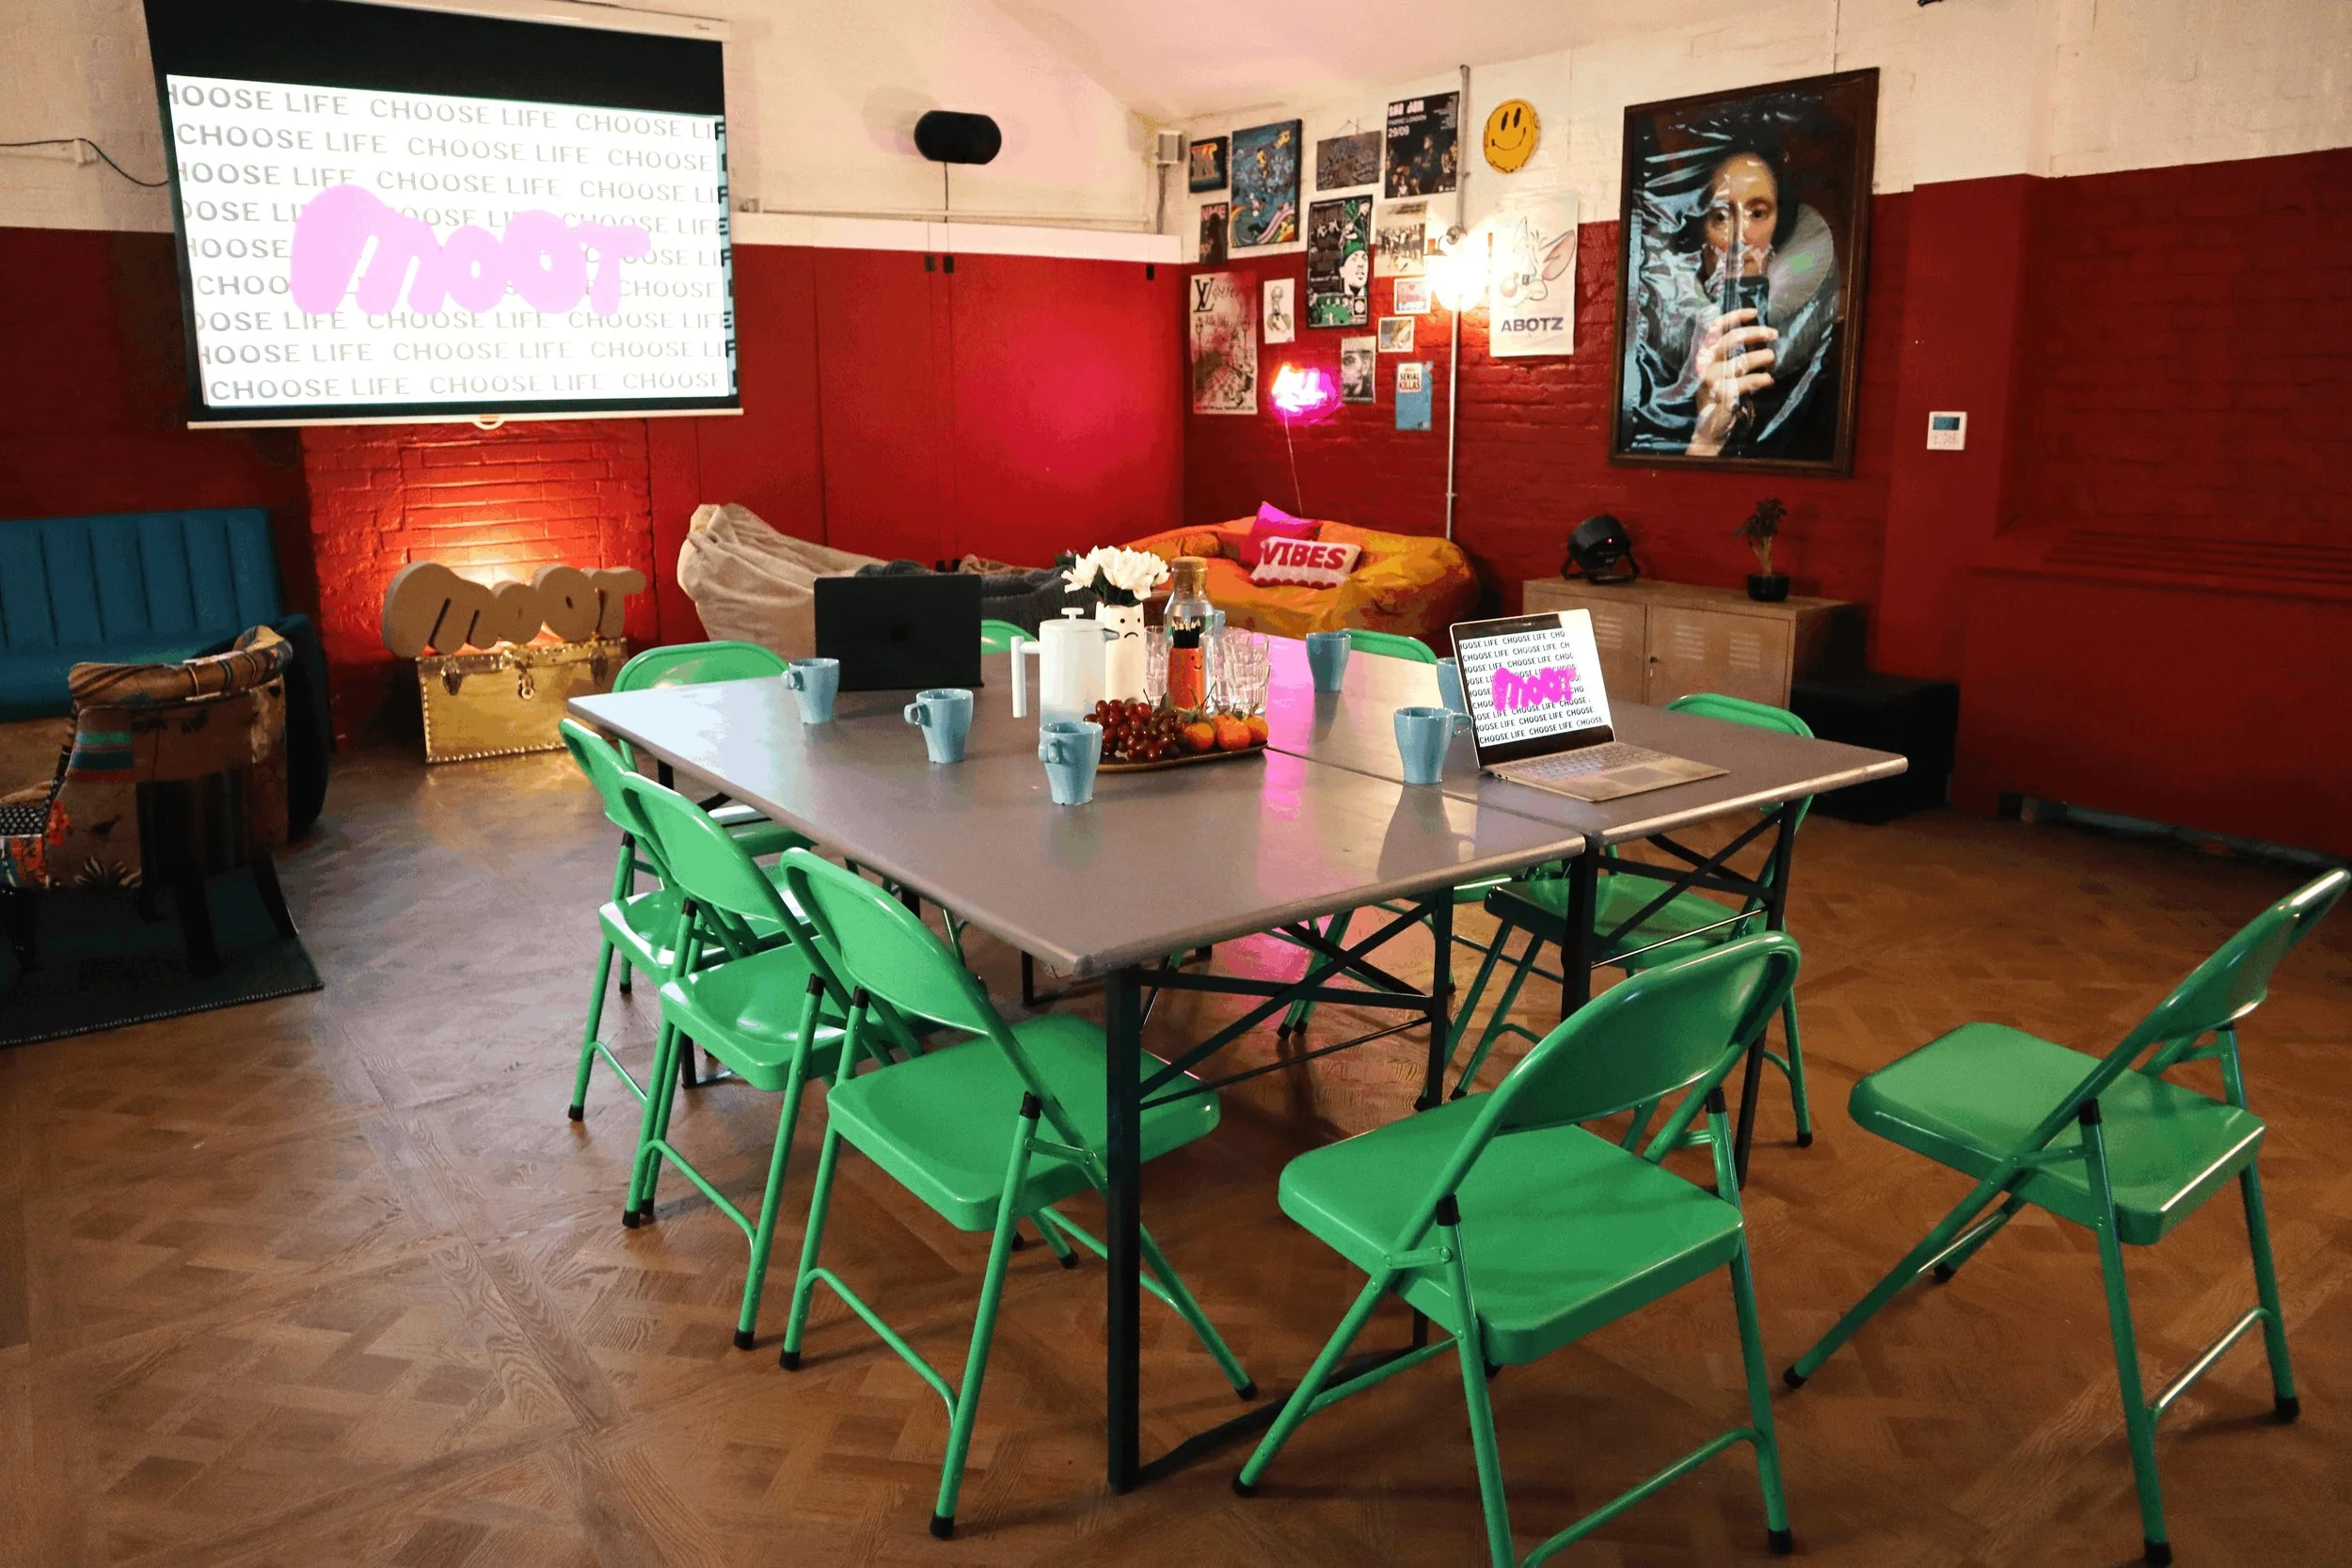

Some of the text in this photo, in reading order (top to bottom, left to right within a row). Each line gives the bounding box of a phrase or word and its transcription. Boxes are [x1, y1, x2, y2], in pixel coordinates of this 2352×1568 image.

[285, 92, 350, 115] LIFE
[370, 99, 490, 124] CHOOSE
[501, 107, 557, 128] LIFE
[575, 113, 682, 137] CHOOSE
[176, 123, 313, 150] CHOOSE
[325, 132, 388, 153] LIFE
[407, 136, 526, 161] CHOOSE
[535, 144, 590, 165] LIFE
[608, 149, 712, 171] CHOOSE
[293, 166, 355, 188] LIFE
[376, 170, 497, 194] CHOOSE
[506, 177, 562, 196] LIFE
[580, 180, 685, 201] CHOOSE
[284, 311, 348, 330] LIFE
[367, 311, 485, 329] CHOOSE
[496, 311, 551, 329] LIFE
[568, 311, 676, 329] CHOOSE
[1501, 317, 1564, 332] ABOTZ
[312, 343, 373, 362] LIFE
[393, 341, 509, 361] CHOOSE
[519, 341, 573, 359] LIFE
[591, 341, 694, 358] CHOOSE
[210, 378, 341, 401] CHOOSE
[351, 377, 410, 396] LIFE
[429, 375, 543, 394] CHOOSE
[552, 373, 604, 391] LIFE
[623, 372, 723, 389] CHOOSE
[1262, 540, 1347, 570] VIBES
[1462, 651, 1492, 661] CHOOSE
[1494, 649, 1509, 658] LIFE
[1512, 645, 1541, 656] CHOOSE
[1543, 642, 1557, 652] LIFE
[1484, 639, 1499, 647] LIFE
[1502, 634, 1532, 645] CHOOSE
[1533, 633, 1547, 641] LIFE
[1488, 662, 1502, 671] LIFE
[1507, 657, 1535, 668] CHOOSE
[1537, 655, 1551, 664] LIFE
[1492, 709, 1508, 719] LIFE
[1511, 705, 1540, 715] CHOOSE
[1541, 702, 1556, 710] LIFE
[1559, 696, 1586, 707] CHOOSE
[1500, 719, 1515, 728] LIFE
[1518, 713, 1548, 725] CHOOSE
[1549, 711, 1563, 721] LIFE
[1565, 705, 1594, 717] CHOOSE
[1479, 716, 1603, 744] CHOOSE LIFE CHOOSE LIFE CHOOSE
